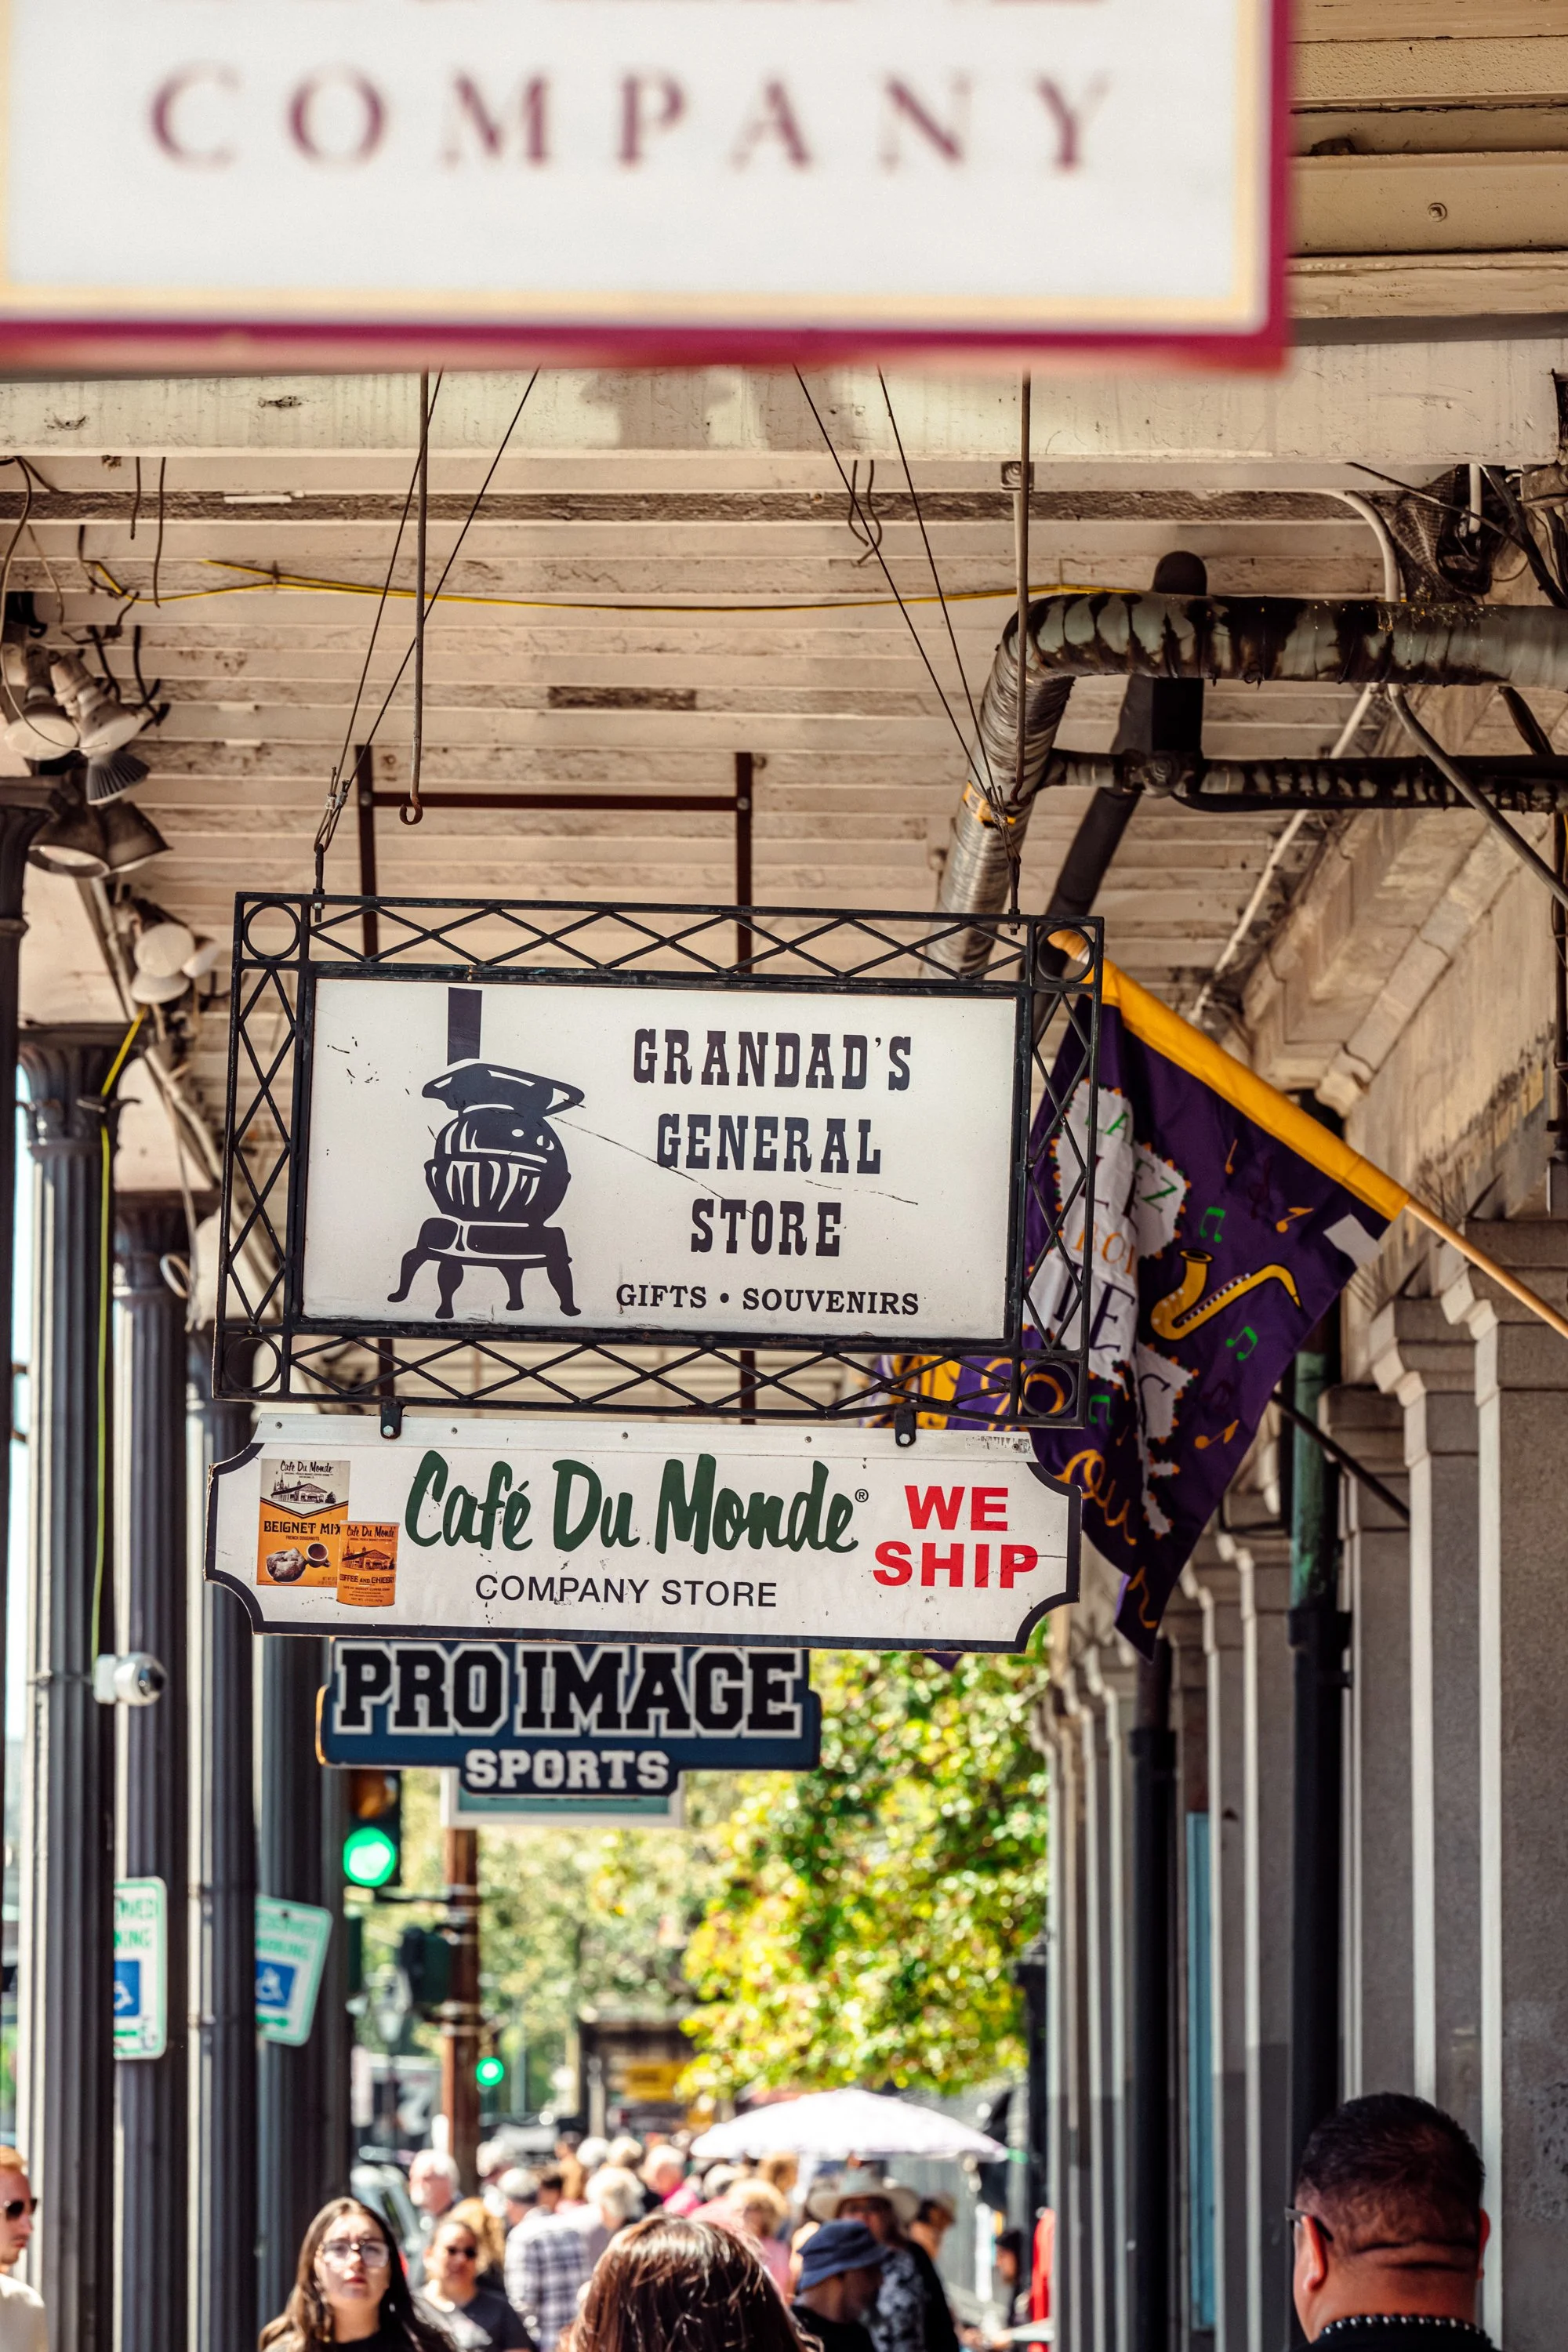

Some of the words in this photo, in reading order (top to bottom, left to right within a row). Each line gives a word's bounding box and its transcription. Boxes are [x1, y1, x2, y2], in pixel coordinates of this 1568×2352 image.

[146, 60, 1112, 172] COMPANY
[633, 1029, 911, 1091] GRANDAD'S
[657, 1113, 881, 1174] GENERAL
[691, 1198, 841, 1257] STORE
[616, 1284, 706, 1308] GIFTS
[742, 1288, 919, 1315] SOUVENIRS
[297, 1461, 307, 1472] Du
[405, 1450, 533, 1551] Café
[553, 1459, 641, 1552] Du
[904, 1485, 1008, 1531] WE
[263, 1521, 317, 1534] BEIGNET
[873, 1541, 1038, 1588] SHIP
[475, 1574, 650, 1604] COMPANY
[661, 1579, 777, 1607] STORE
[466, 1748, 670, 1789] SPORTS
